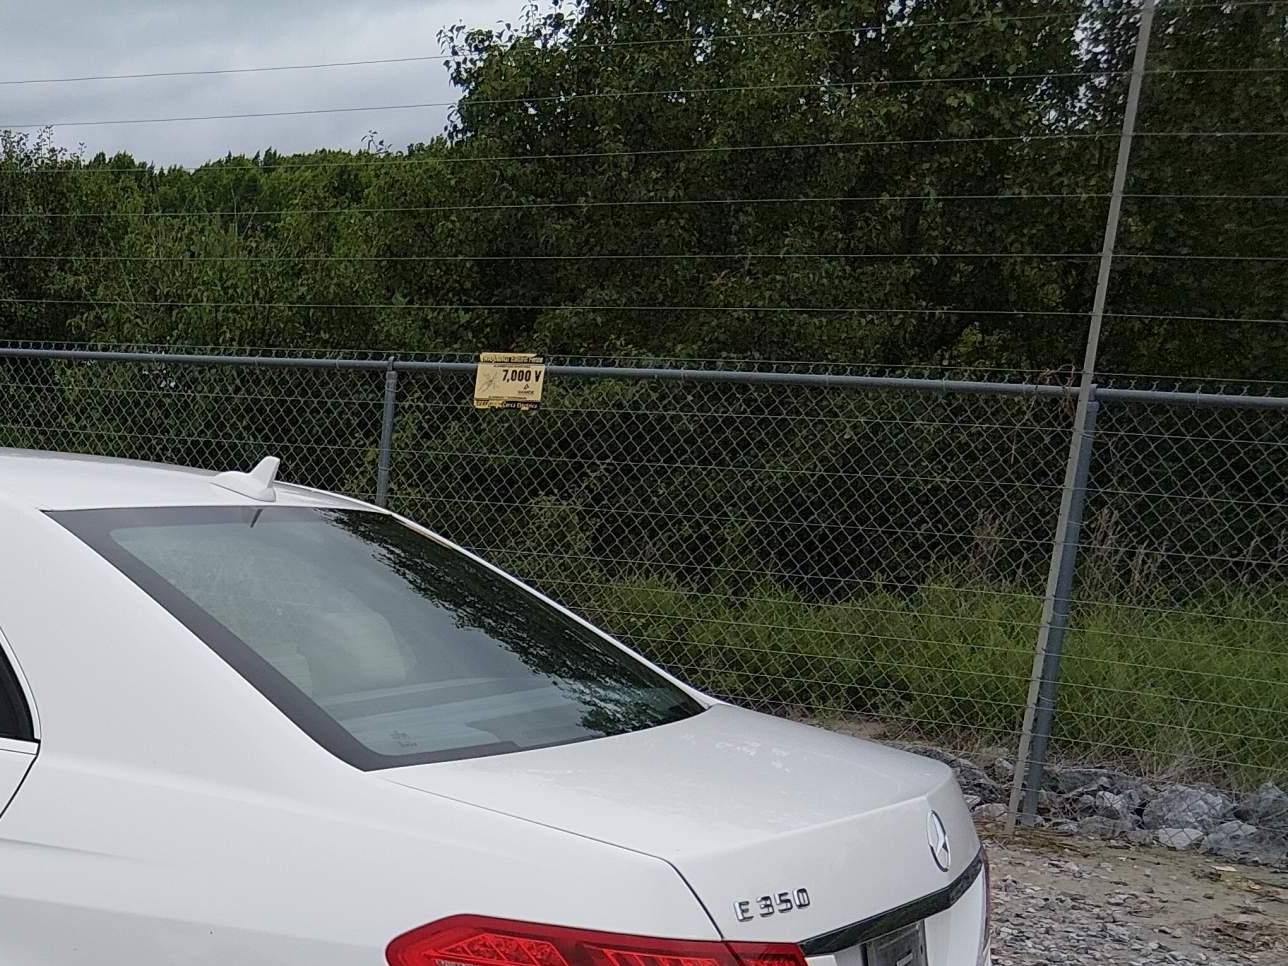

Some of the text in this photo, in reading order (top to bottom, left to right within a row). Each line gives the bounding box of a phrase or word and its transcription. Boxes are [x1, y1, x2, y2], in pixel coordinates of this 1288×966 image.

[502, 369, 542, 383] 7,000 V
[733, 888, 811, 922] E 350
